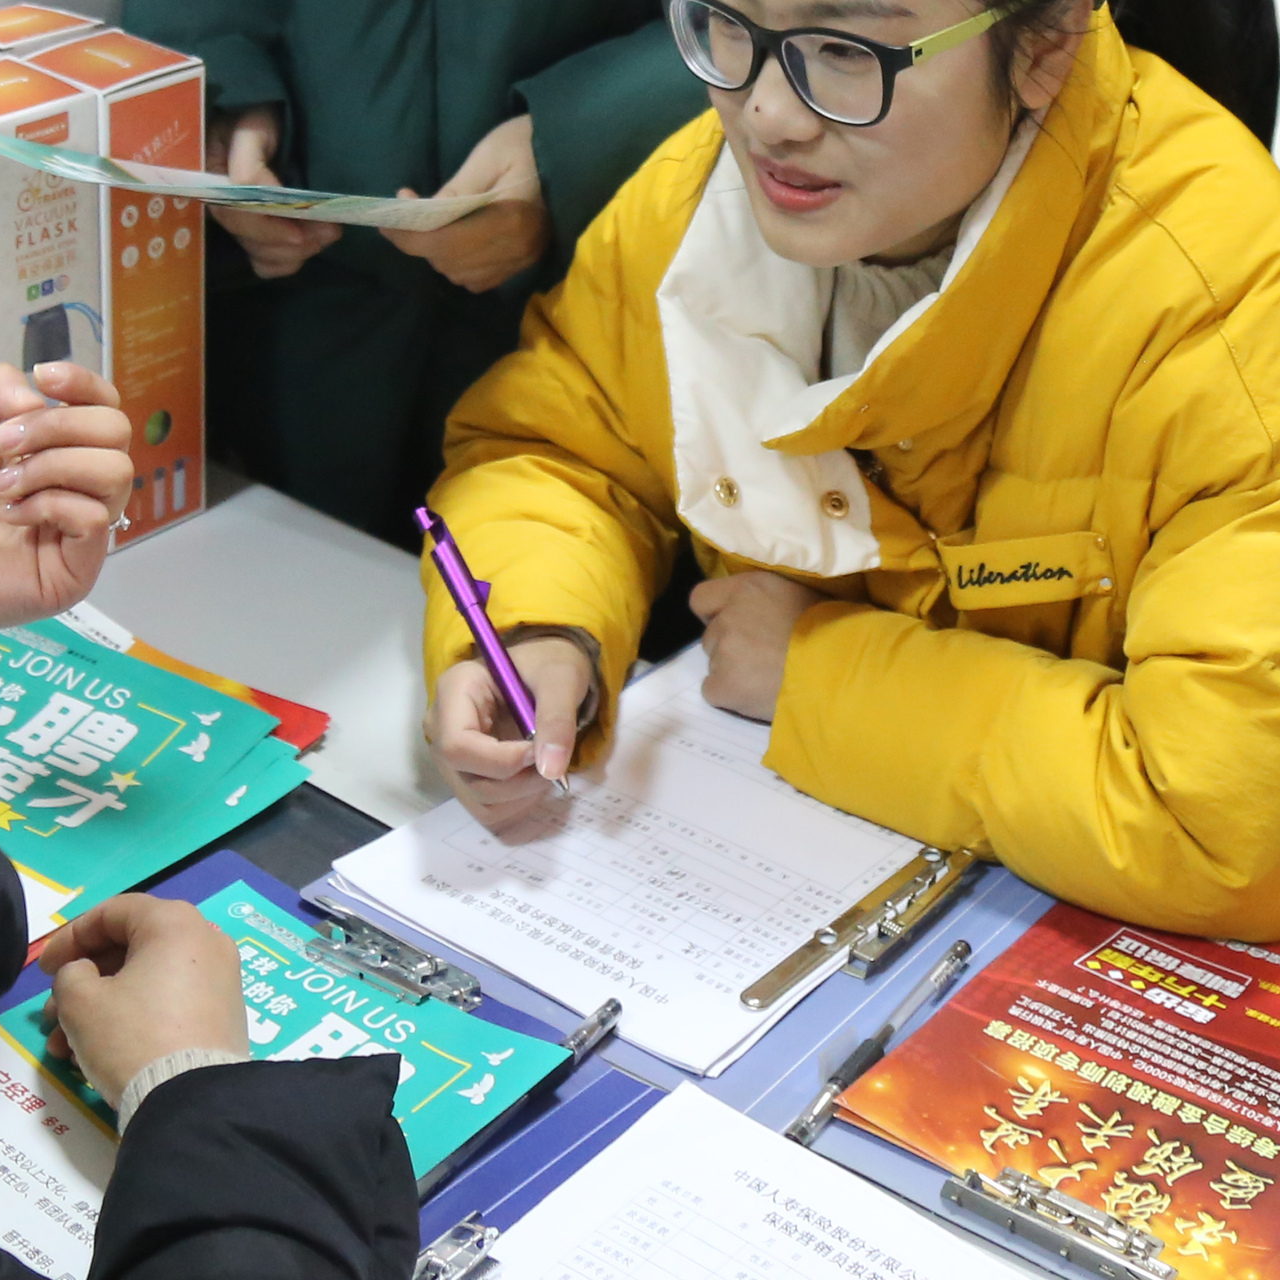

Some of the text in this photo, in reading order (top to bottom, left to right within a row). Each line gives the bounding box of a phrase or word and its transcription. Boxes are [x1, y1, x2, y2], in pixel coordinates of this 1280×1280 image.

[14, 201, 78, 232] VACUUM
[15, 218, 78, 249] FLASK
[958, 562, 1073, 590] Liberation
[8, 650, 87, 691] JOIN
[83, 678, 132, 709] US
[238, 945, 279, 976] 寻找
[1094, 946, 1232, 1012] 十万年薪
[1110, 934, 1247, 999] 制度保证
[245, 981, 298, 1016] 的你
[284, 967, 369, 1014] JOIN
[361, 1006, 416, 1043] US
[1140, 984, 1217, 1025] 起步
[41, 1116, 71, 1136] 多名
[733, 1169, 932, 1280] 中国人寿保险股份有限公
